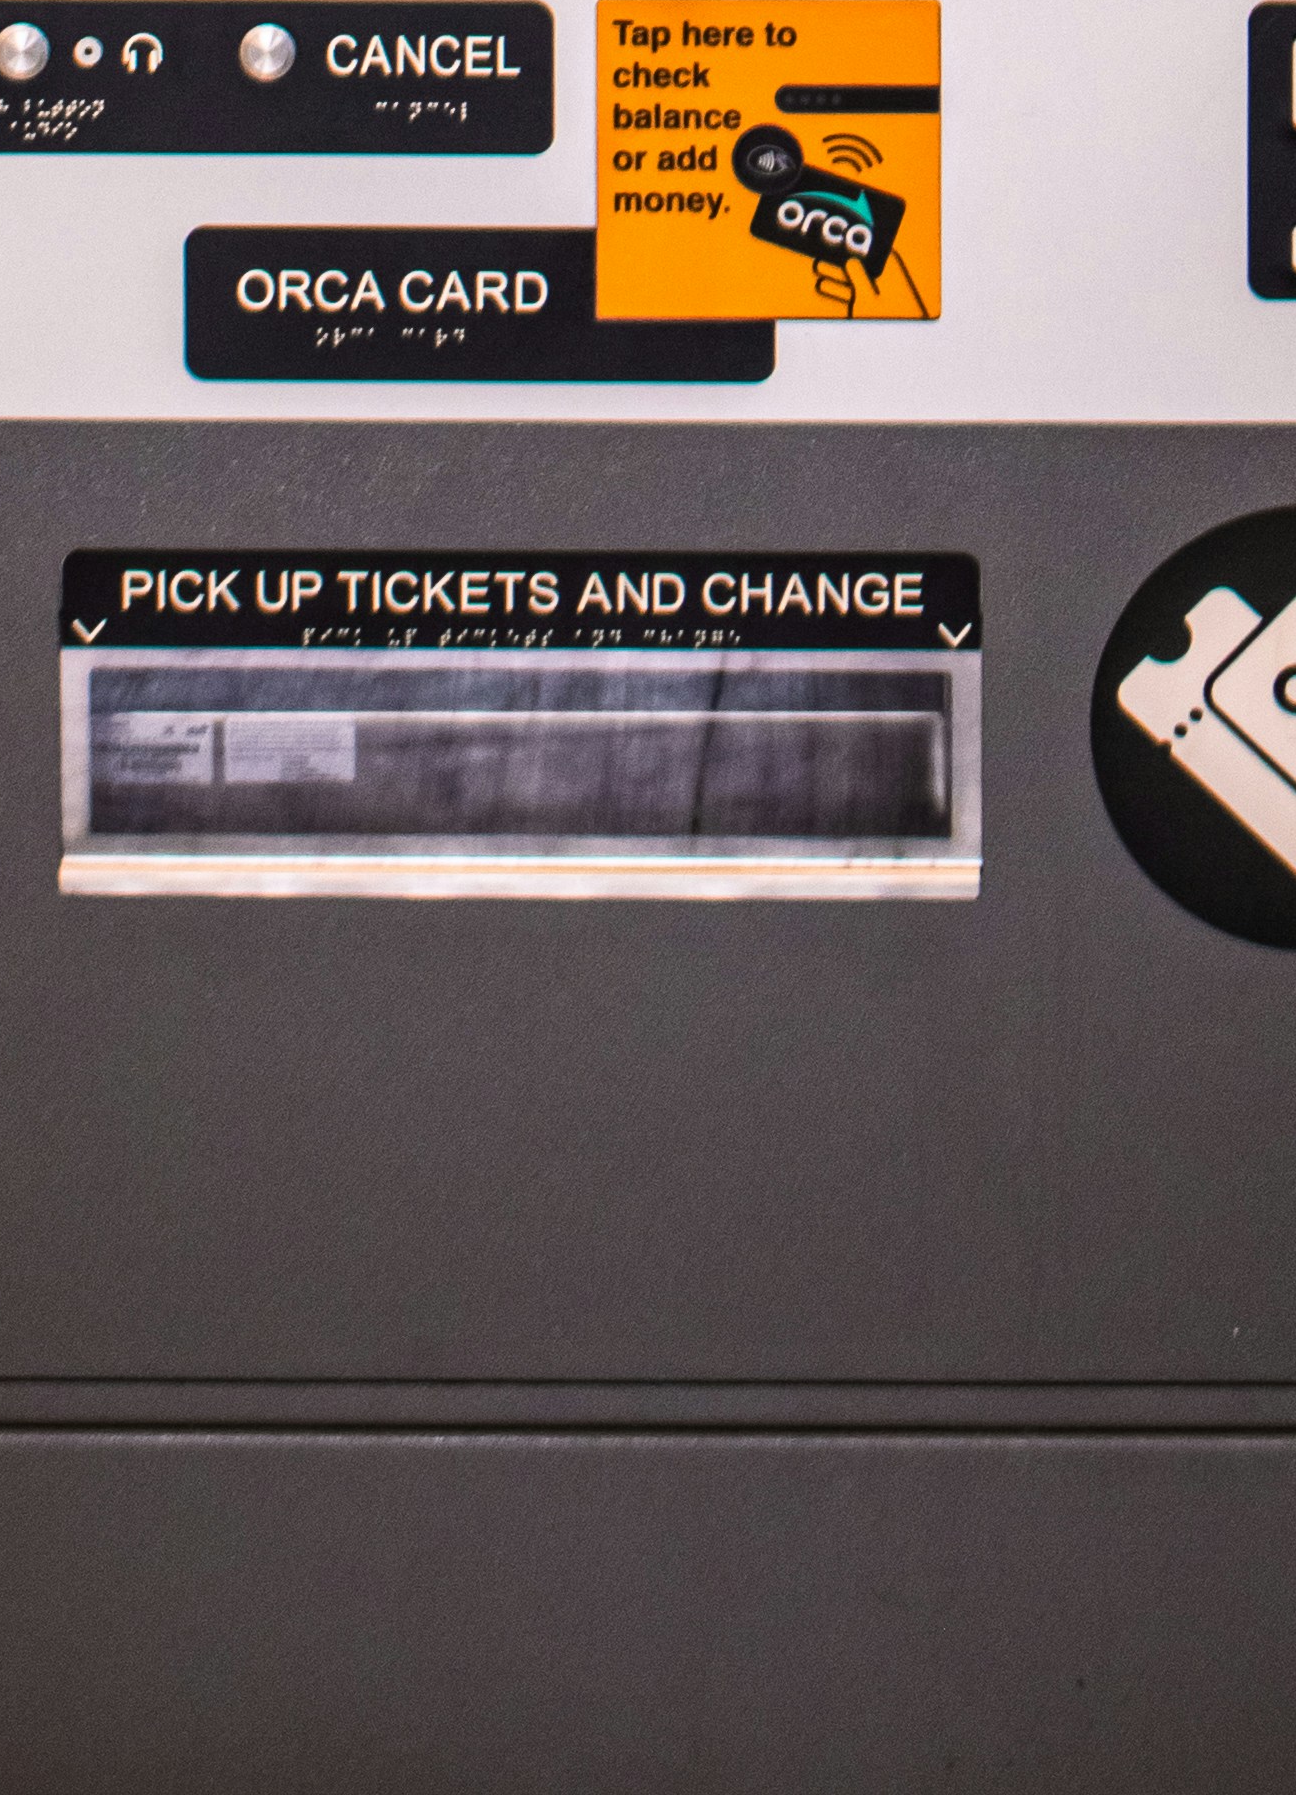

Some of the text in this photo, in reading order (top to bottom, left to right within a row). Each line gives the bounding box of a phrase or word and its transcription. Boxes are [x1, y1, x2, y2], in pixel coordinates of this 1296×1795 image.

[613, 20, 797, 53] Tap here to
[327, 35, 520, 76] CANCEL
[614, 62, 709, 88] check
[613, 104, 741, 129] balance
[613, 146, 717, 171] or add
[614, 193, 729, 219] money.
[777, 199, 873, 257] orca
[237, 269, 547, 311] ORCA CARD
[123, 570, 923, 614] PICK UP TICKETS AND CHANGE
